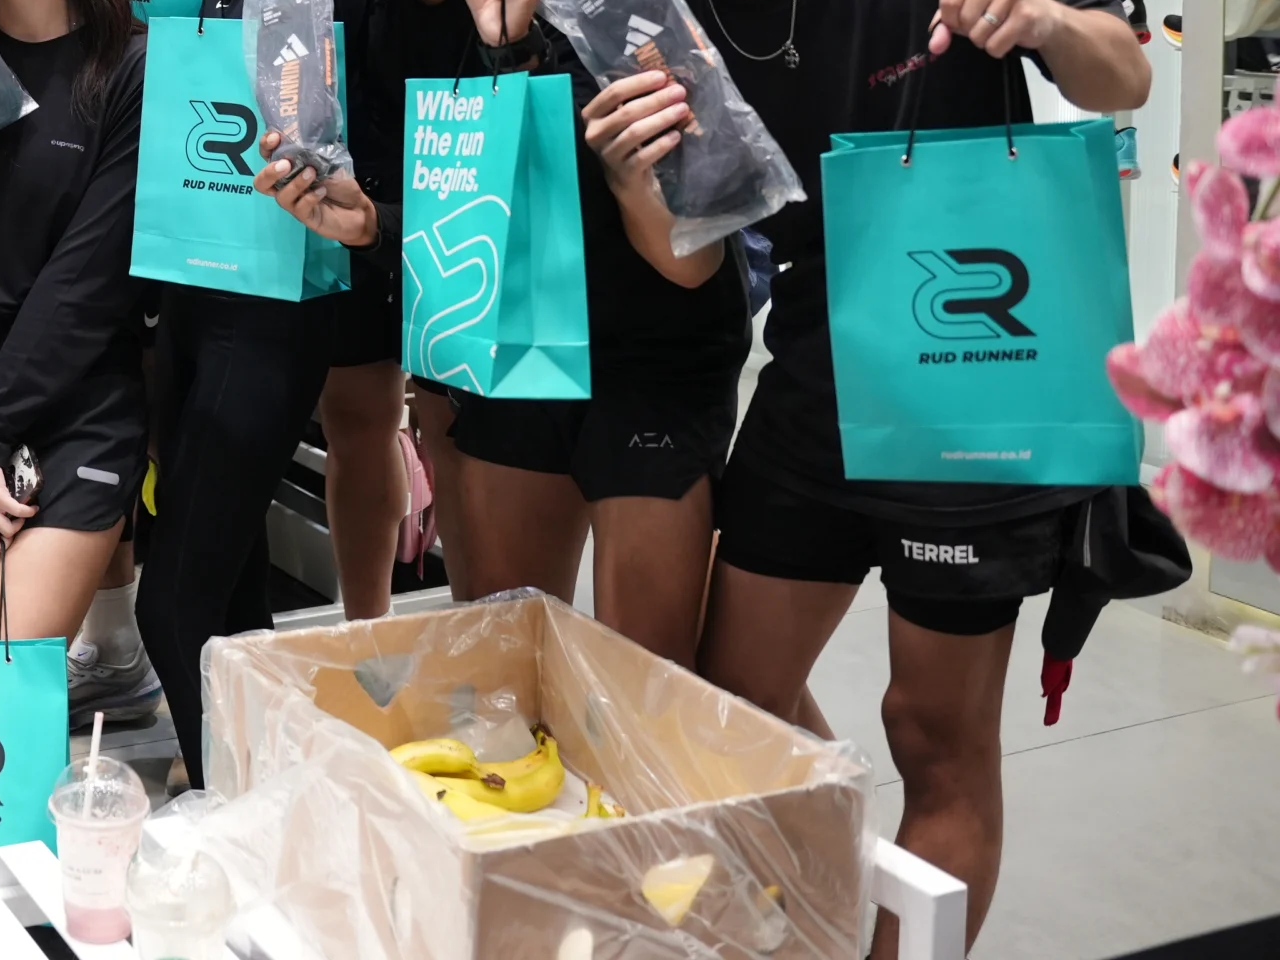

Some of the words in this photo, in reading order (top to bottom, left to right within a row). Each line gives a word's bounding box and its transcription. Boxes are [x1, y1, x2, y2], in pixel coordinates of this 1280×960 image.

[416, 90, 483, 121] Where
[414, 125, 452, 157] the
[454, 130, 484, 157] run
[182, 178, 206, 190] RUD
[208, 181, 254, 196] RUNNER
[412, 160, 479, 200] begins.
[186, 258, 239, 272] rudrunner.co.id
[918, 351, 957, 365] RUD
[962, 348, 1039, 363] RUNNER
[901, 538, 980, 564] TERREL
